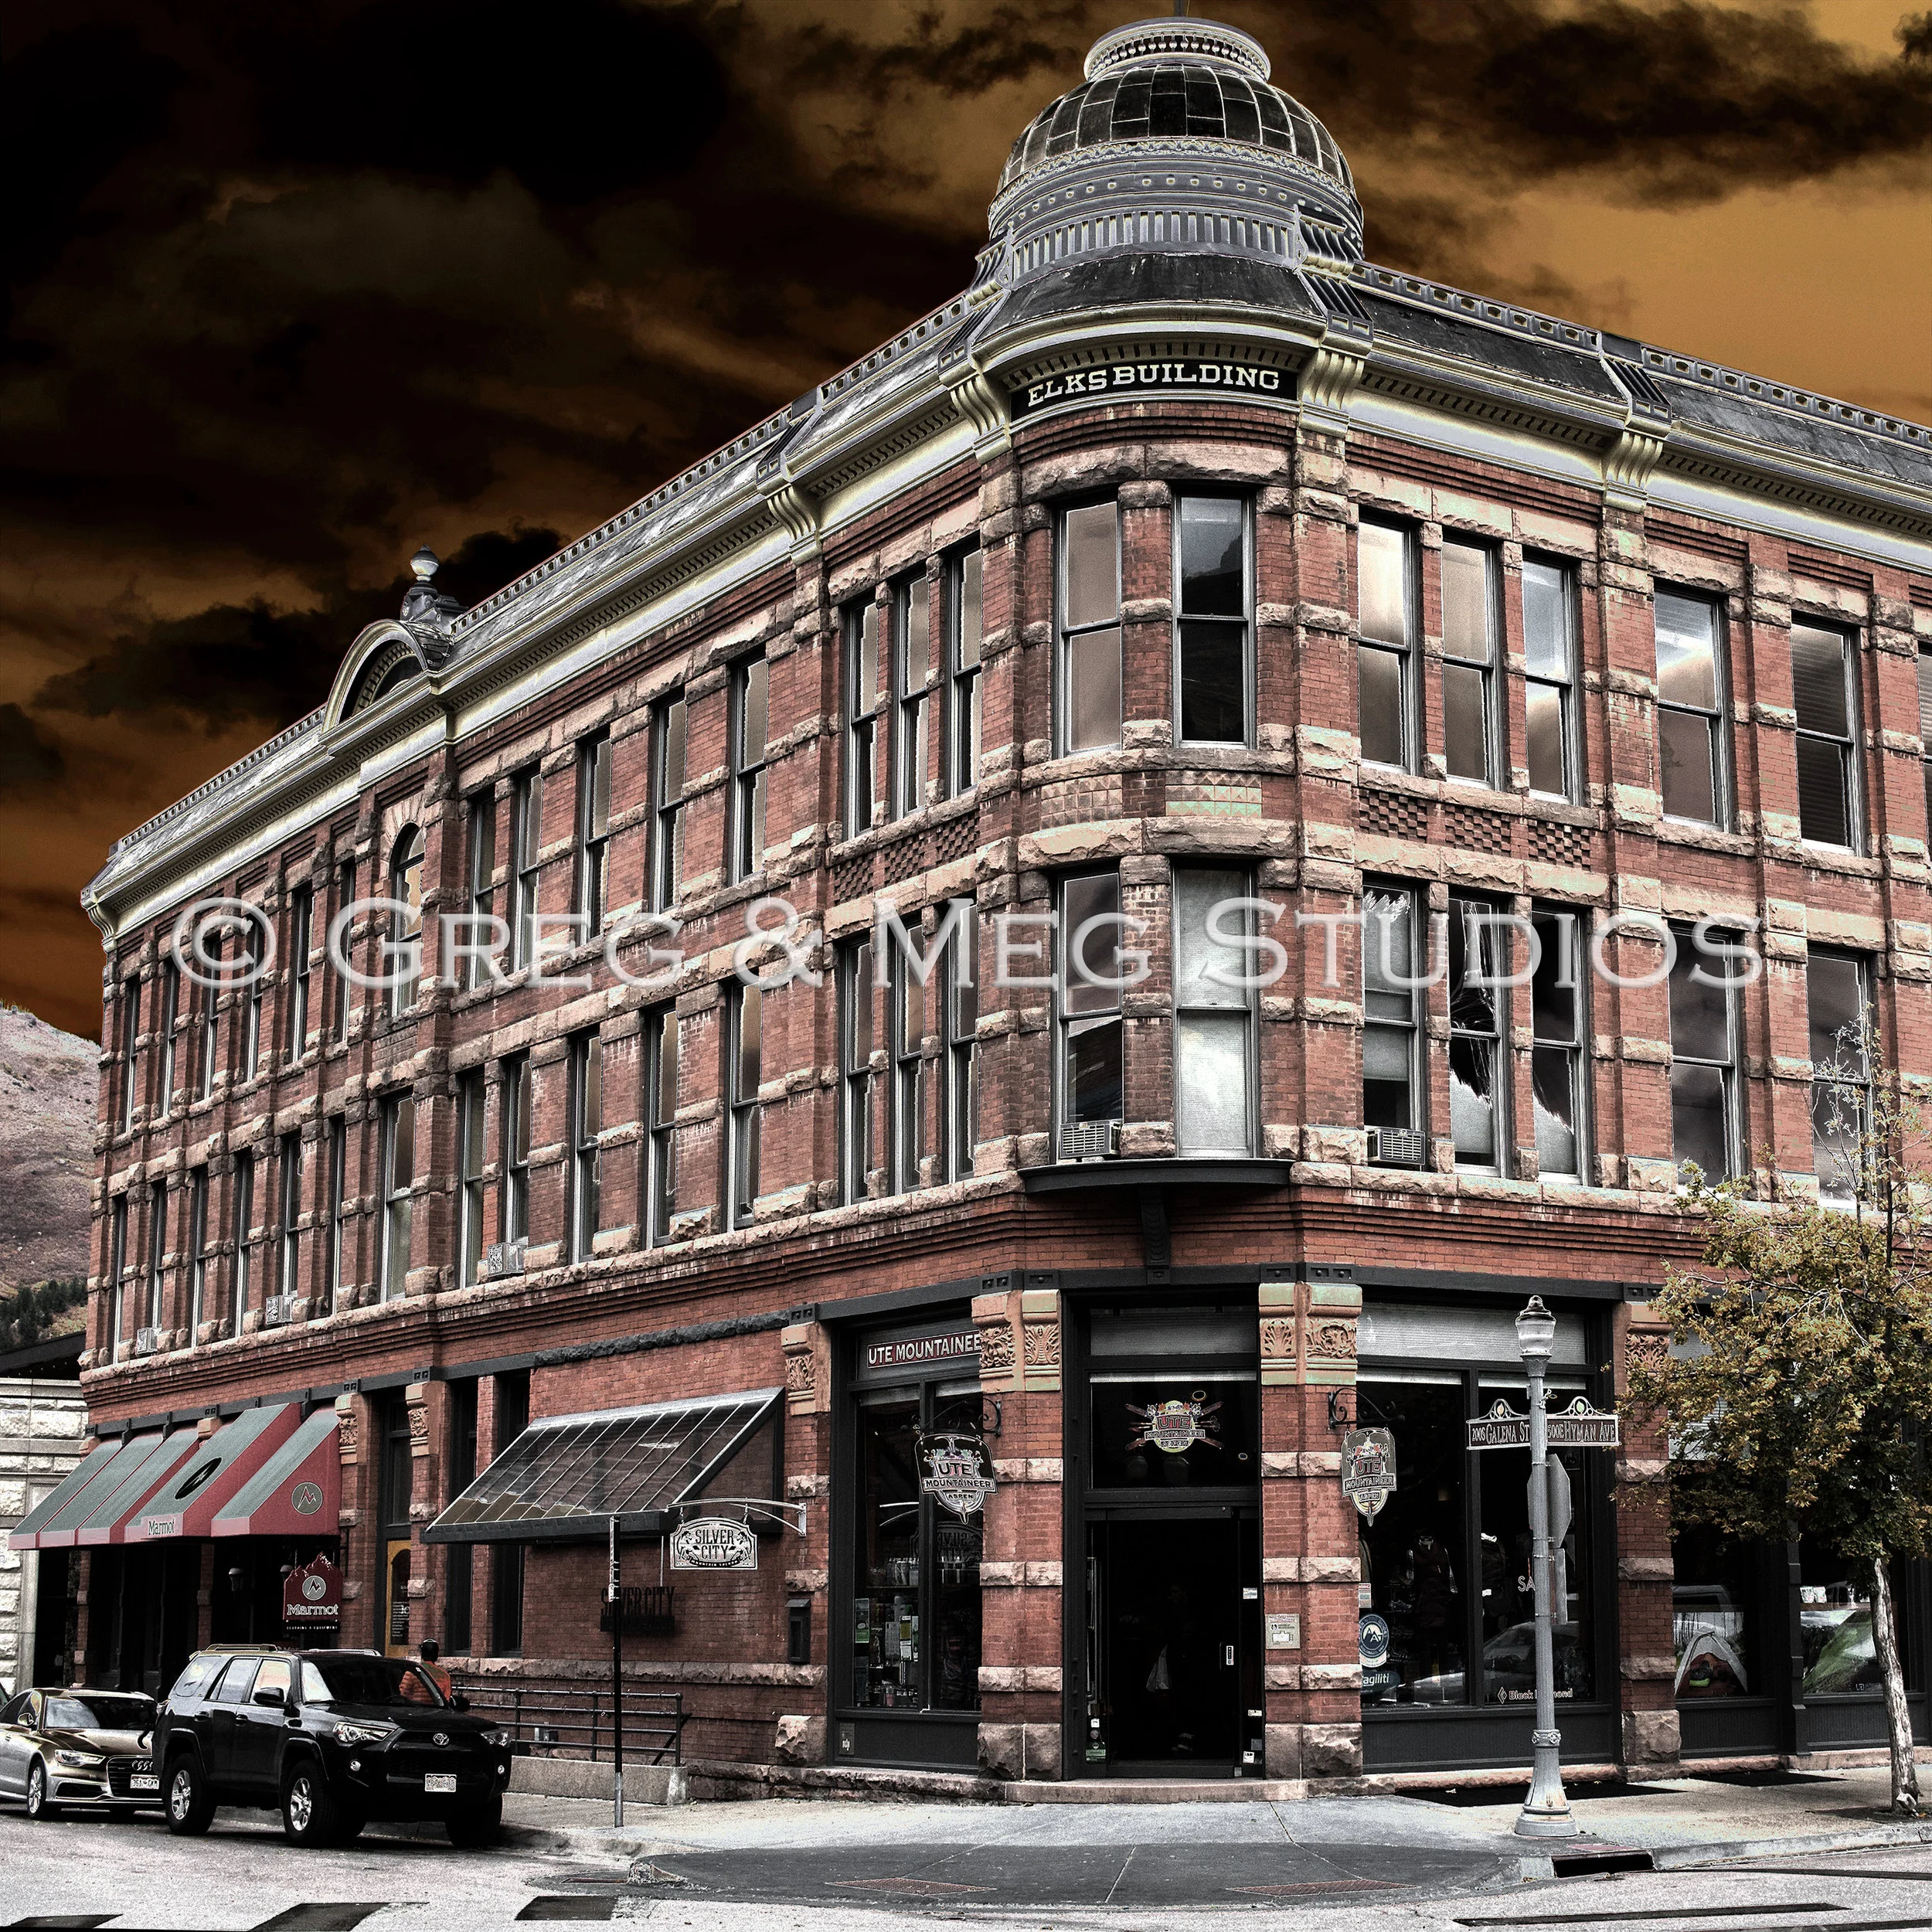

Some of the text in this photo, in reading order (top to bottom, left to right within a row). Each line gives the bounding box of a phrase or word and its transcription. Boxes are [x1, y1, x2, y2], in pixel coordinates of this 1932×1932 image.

[1028, 363, 1280, 406] ELKS BUILDING
[869, 1333, 981, 1365] UTE MOUNTAINEE
[1159, 1417, 1189, 1429] UTE
[1146, 1430, 1205, 1438] MOUNTAINEER
[1485, 1423, 1517, 1444] GALENA
[1519, 1421, 1530, 1442] ST
[1563, 1420, 1597, 1441] HYMAN
[1599, 1422, 1615, 1441] AVE
[938, 1462, 972, 1476] UTE
[1355, 1459, 1381, 1475] UTE
[926, 1478, 992, 1488] MOUNTAINEER
[1345, 1476, 1394, 1490] MOUNTAINEER
[148, 1519, 175, 1536] Marmot
[696, 1529, 735, 1545] SILVER
[702, 1546, 729, 1560] CITY
[287, 1604, 338, 1616] Marmot
[1509, 1689, 1534, 1700] Black
